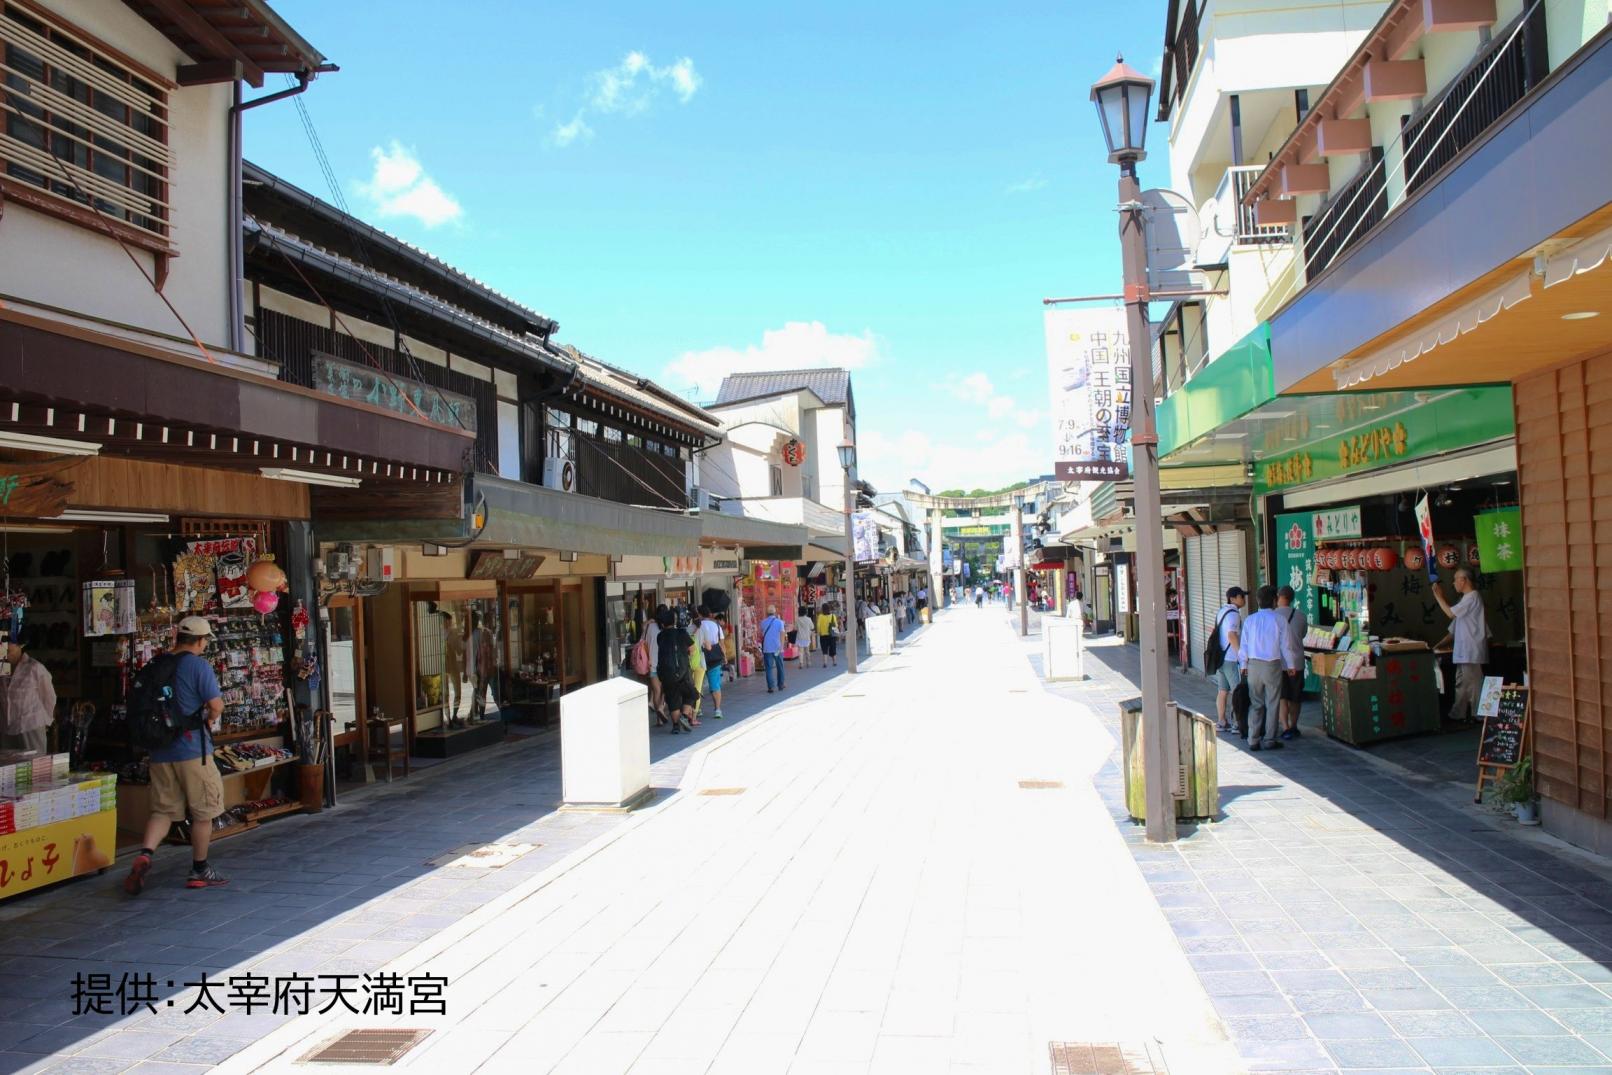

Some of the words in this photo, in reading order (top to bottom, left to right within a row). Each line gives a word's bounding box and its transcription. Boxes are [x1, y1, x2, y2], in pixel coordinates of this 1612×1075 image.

[1111, 329, 1131, 463] 九州国立博物館
[1493, 521, 1513, 561] 抹茶
